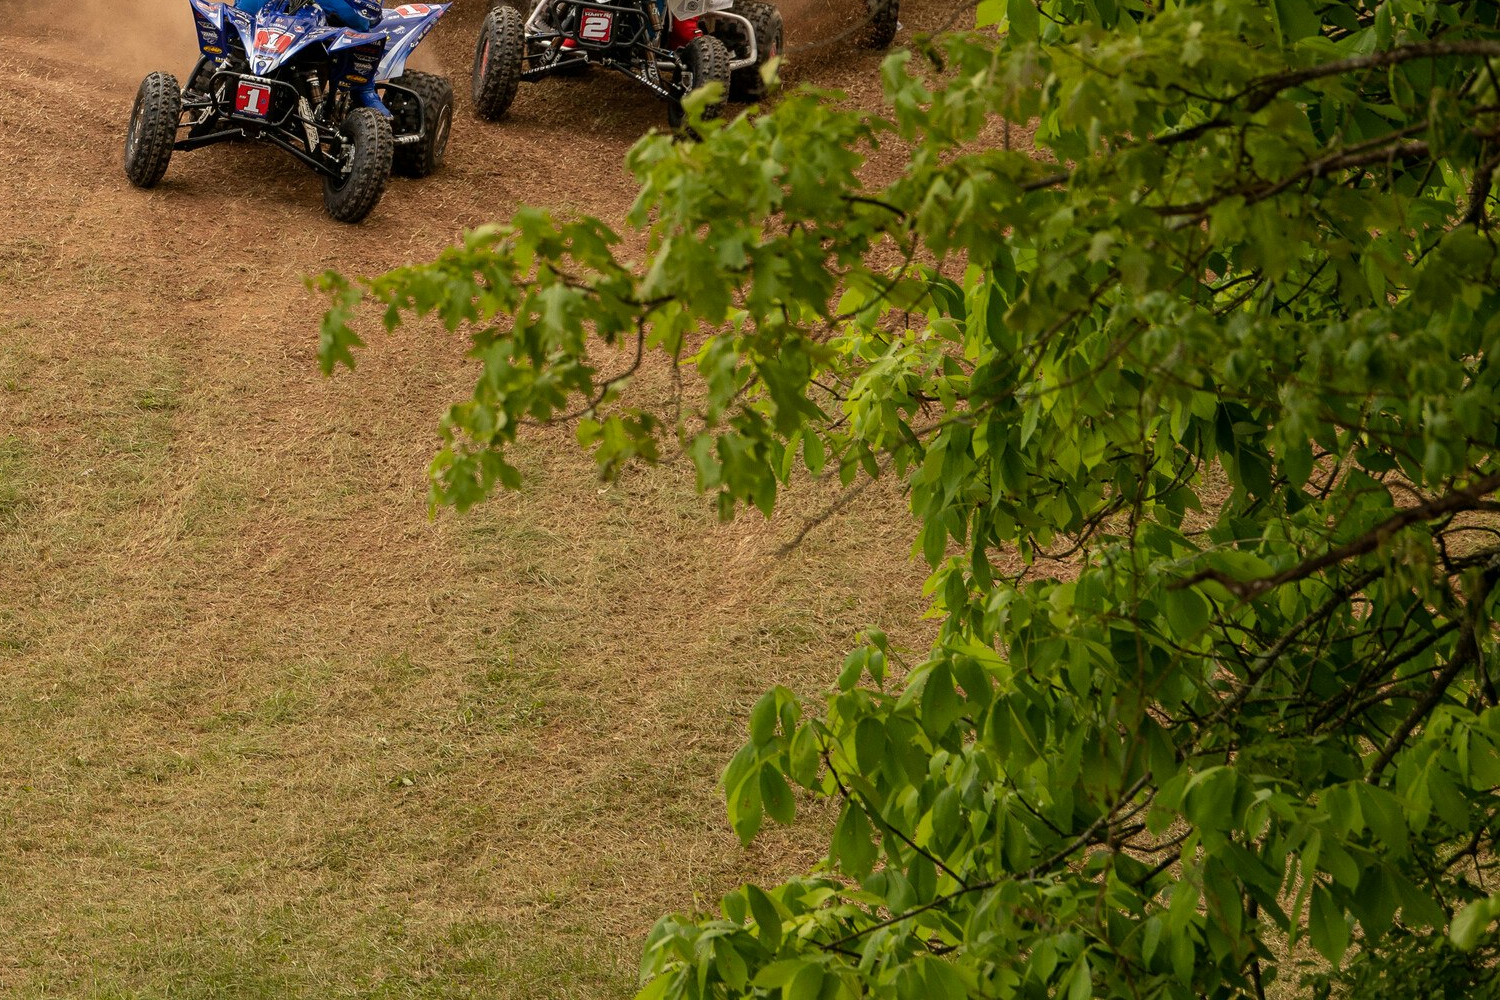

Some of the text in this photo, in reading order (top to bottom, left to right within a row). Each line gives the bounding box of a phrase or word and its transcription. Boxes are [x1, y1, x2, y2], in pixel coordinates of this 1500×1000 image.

[582, 17, 610, 39] 2
[263, 32, 280, 50] 1
[246, 89, 261, 113] 1
